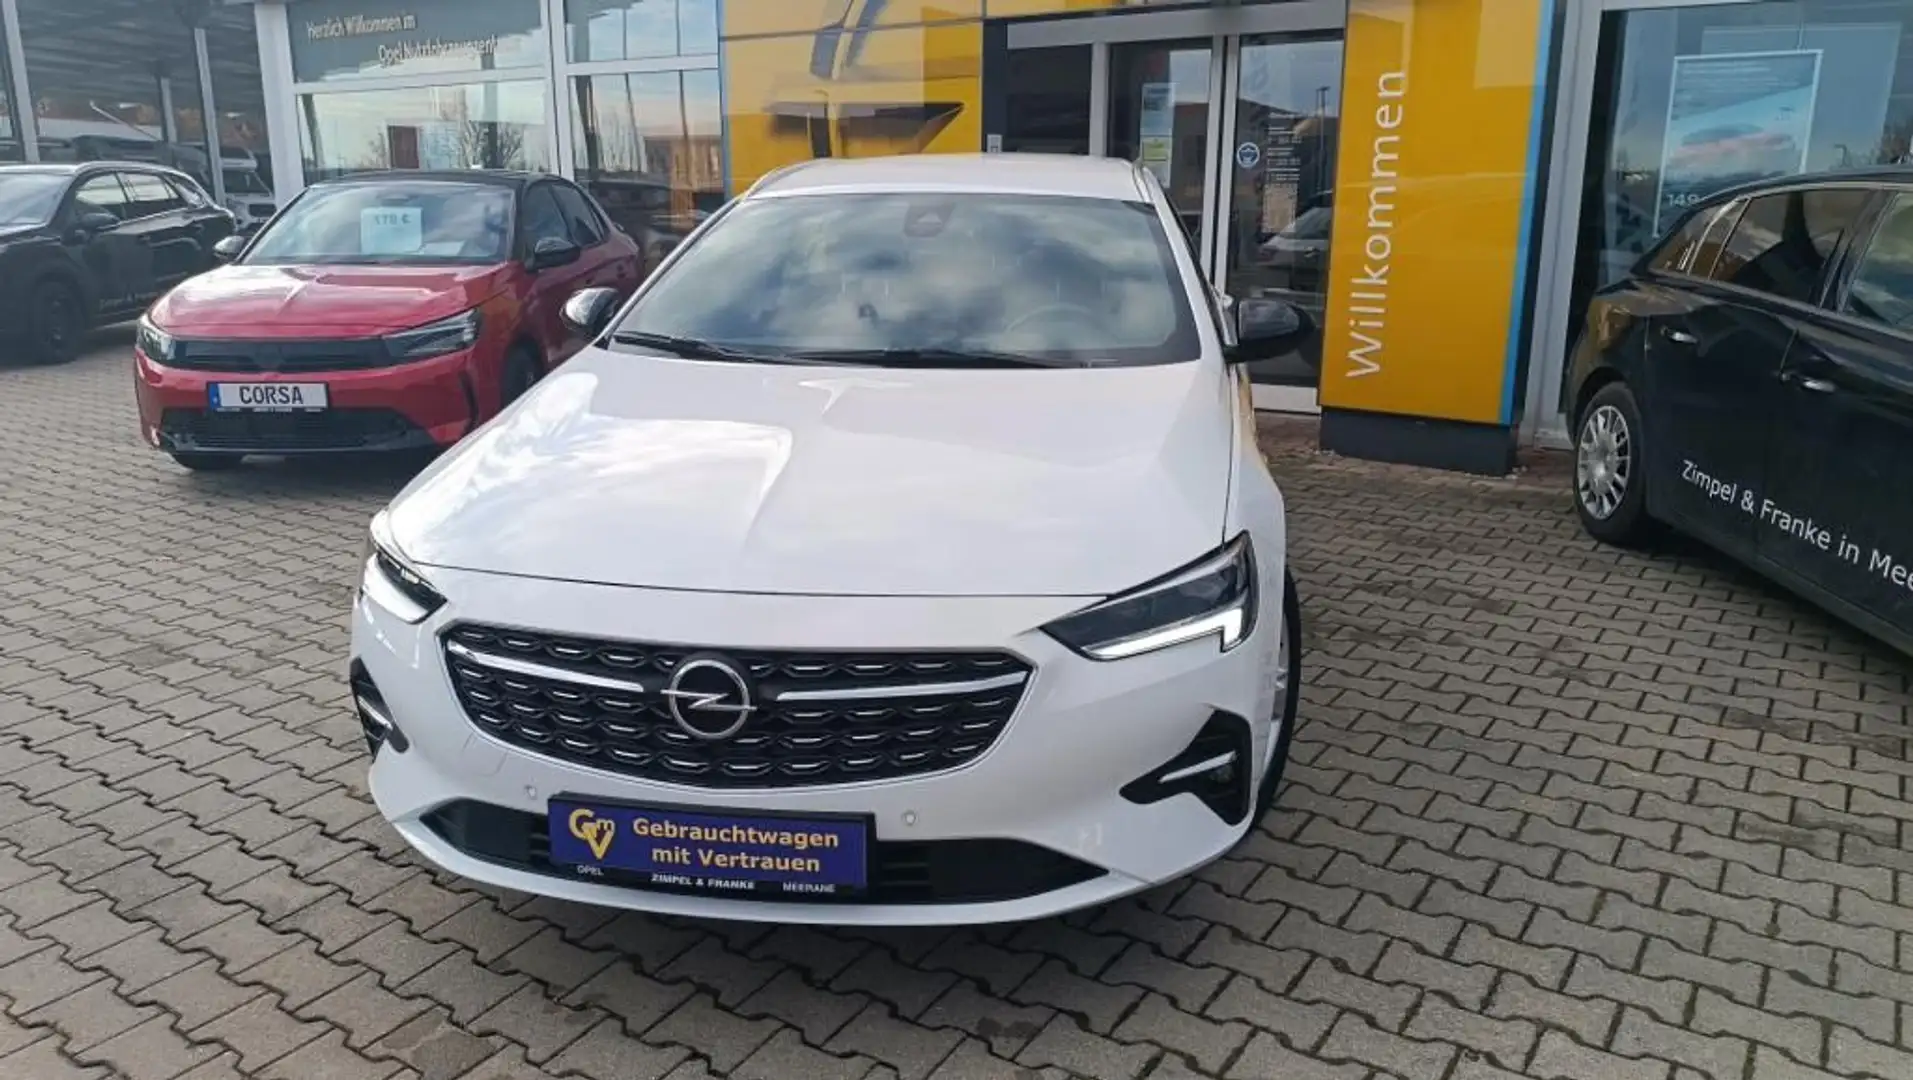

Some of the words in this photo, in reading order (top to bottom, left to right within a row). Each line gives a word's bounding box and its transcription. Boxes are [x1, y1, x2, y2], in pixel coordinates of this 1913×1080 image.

[1345, 71, 1406, 377] Willkommen
[239, 385, 304, 405] CORSA
[1682, 459, 1738, 504] Zimpel
[1741, 489, 1754, 515] &
[1760, 499, 1831, 550] Franke
[1837, 533, 1860, 565] in
[632, 817, 840, 850] Gebrauchtwagen
[576, 864, 605, 877] OPEL
[652, 847, 691, 866] mit
[697, 848, 821, 873] Vertrauen
[651, 873, 692, 887] ZIMPEL
[707, 879, 755, 891] FRANKE
